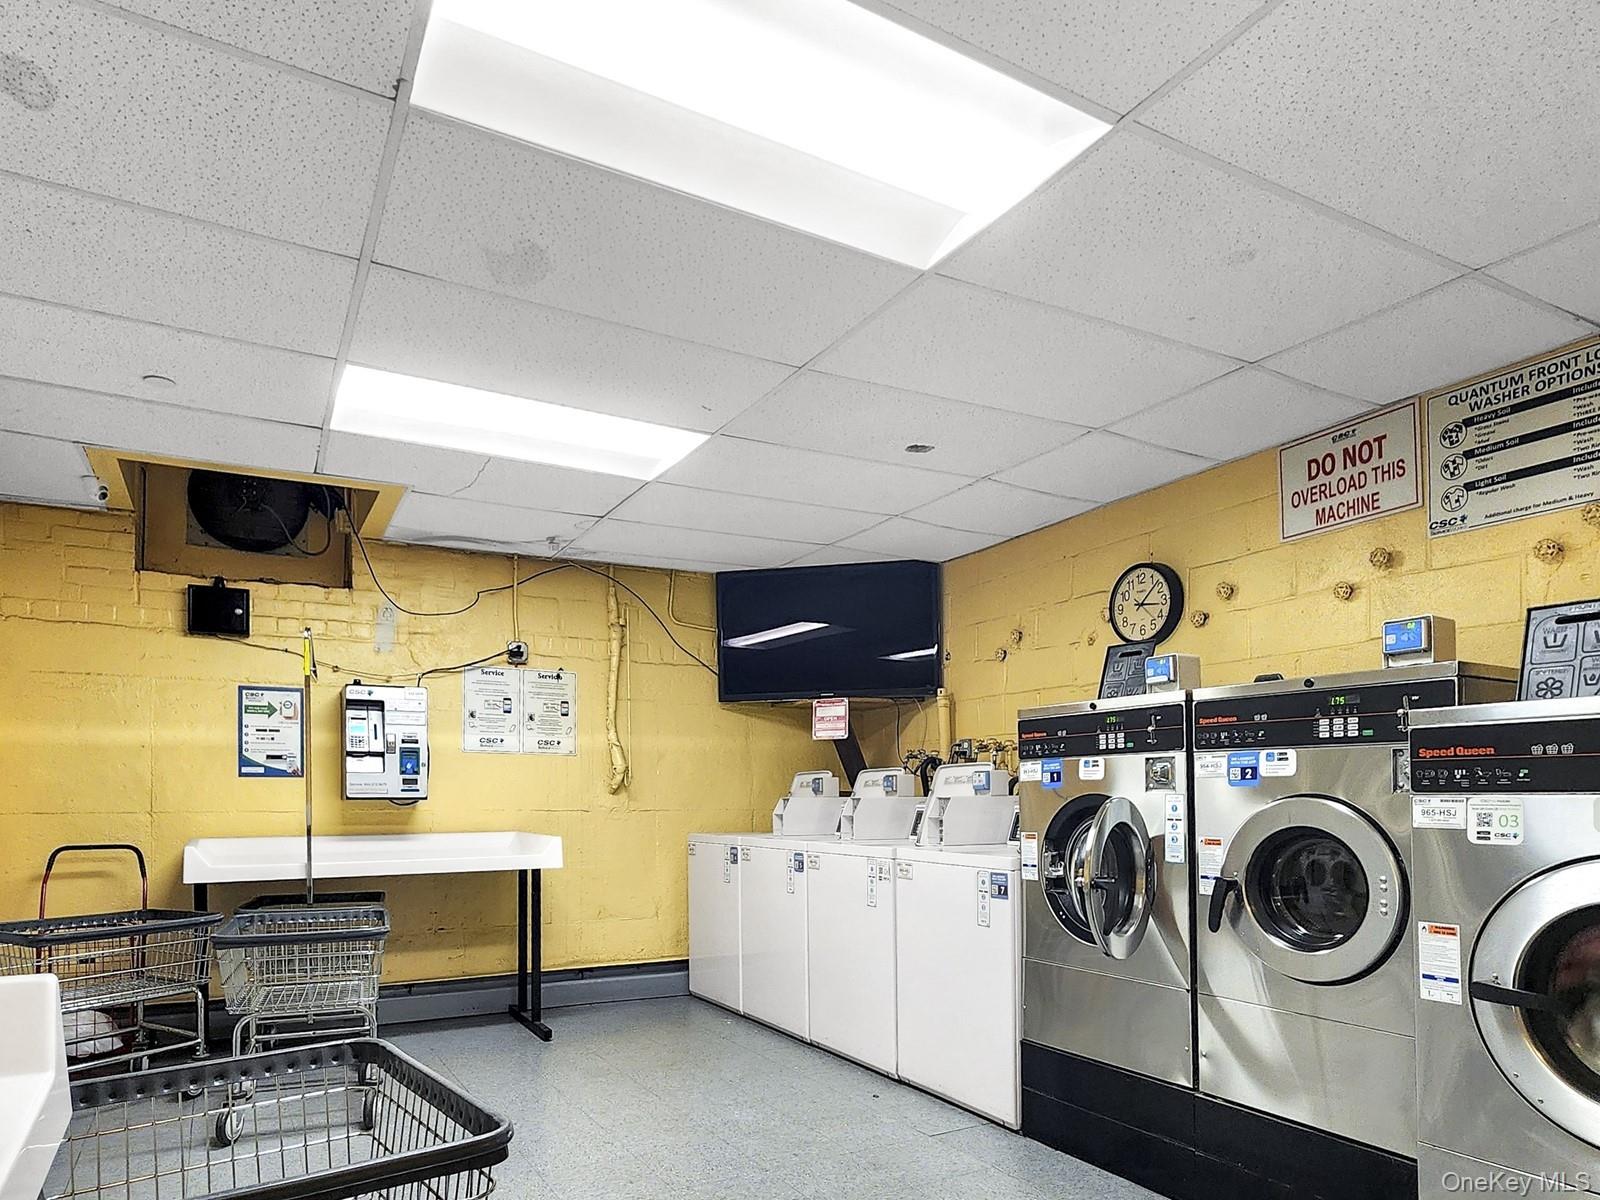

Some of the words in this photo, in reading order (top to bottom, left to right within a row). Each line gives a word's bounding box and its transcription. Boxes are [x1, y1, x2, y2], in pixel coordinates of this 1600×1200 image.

[1448, 373, 1524, 406] QUANTUM
[1528, 355, 1581, 381] FRONT
[1468, 385, 1530, 413] WASHER
[1474, 412, 1496, 424] Heavy
[1497, 407, 1511, 417] Soil
[1474, 443, 1505, 455] Medium
[1506, 437, 1519, 447] Soil
[1307, 452, 1336, 482] DO
[1342, 434, 1387, 471] NOT
[1291, 471, 1368, 509] OVERLOAD
[1371, 458, 1406, 485] THIS
[1475, 477, 1492, 488] Light
[1494, 474, 1507, 483] Soil
[1315, 492, 1381, 527] MACHINE
[1484, 509, 1512, 520] Additional
[1513, 504, 1532, 513] charge
[1533, 500, 1542, 508] for
[1542, 497, 1567, 507] Medium
[1575, 491, 1594, 500] Heavy
[1429, 517, 1458, 530] CSC
[1127, 579, 1135, 591] 11
[1136, 572, 1146, 585] 12
[1157, 581, 1164, 594] 2
[1120, 590, 1130, 603] 10
[1160, 593, 1168, 606] 3
[1117, 603, 1124, 616] 9
[1157, 608, 1164, 620] 4
[1122, 616, 1129, 628] 8
[1129, 622, 1137, 635] 7
[1150, 618, 1157, 631] 5
[1139, 624, 1146, 636] 6
[480, 669, 505, 677] Service
[349, 688, 367, 696] CSC
[1199, 716, 1218, 724] Speed
[1419, 747, 1455, 758] Speed
[1455, 746, 1495, 756] Queen
[1052, 772, 1058, 782] 1
[1244, 768, 1253, 779] 2
[1420, 808, 1457, 817] 965-HSJ
[1498, 814, 1520, 828] 03
[999, 885, 1006, 895] 7
